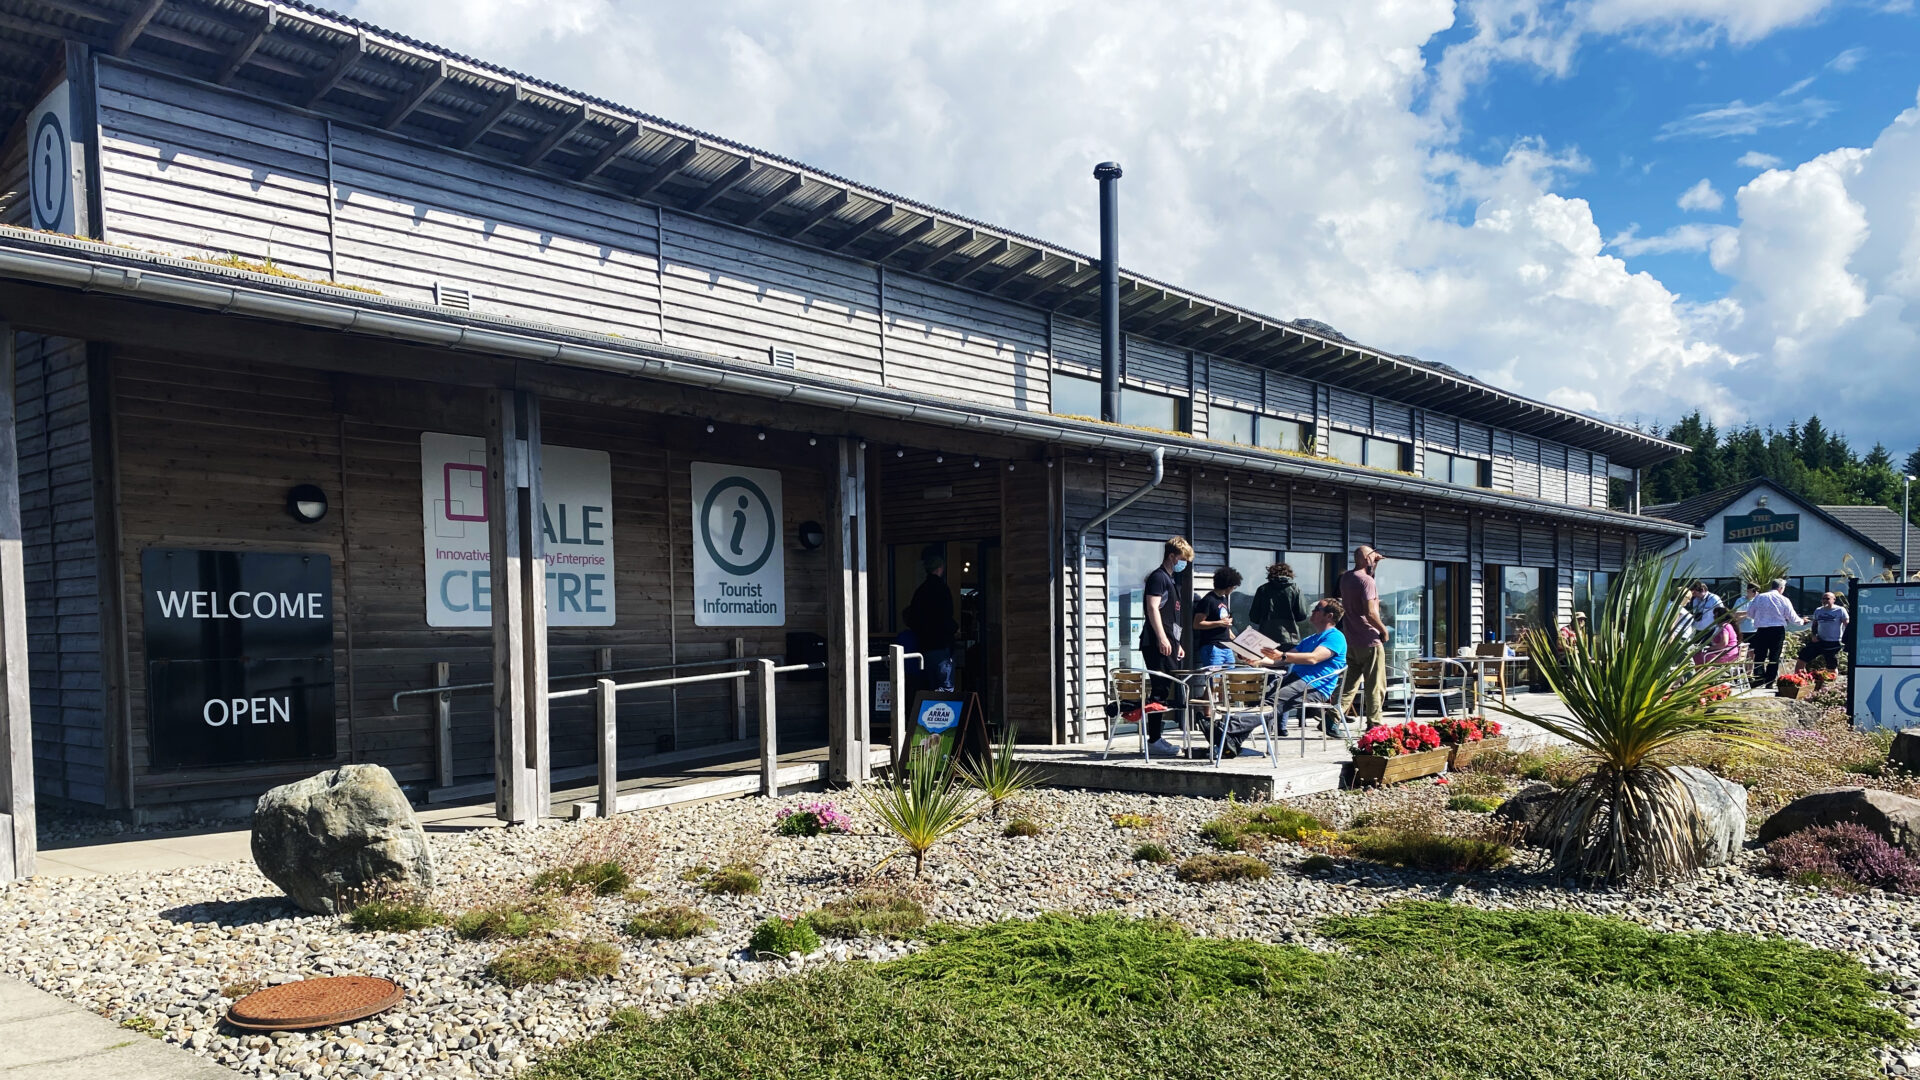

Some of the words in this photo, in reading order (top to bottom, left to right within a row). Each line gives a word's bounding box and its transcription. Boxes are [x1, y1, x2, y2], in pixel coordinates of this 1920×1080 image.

[542, 502, 604, 546] ALE
[1728, 520, 1794, 540] SHIELING
[436, 547, 491, 562] Innovative
[556, 552, 605, 568] Enterprise
[439, 569, 607, 613] CERE
[718, 581, 763, 598] Tourist
[156, 590, 324, 619] WELCOME
[703, 597, 777, 615] Information
[1858, 604, 1880, 614] The
[1883, 603, 1915, 614] GALE
[203, 696, 290, 727] OPEN
